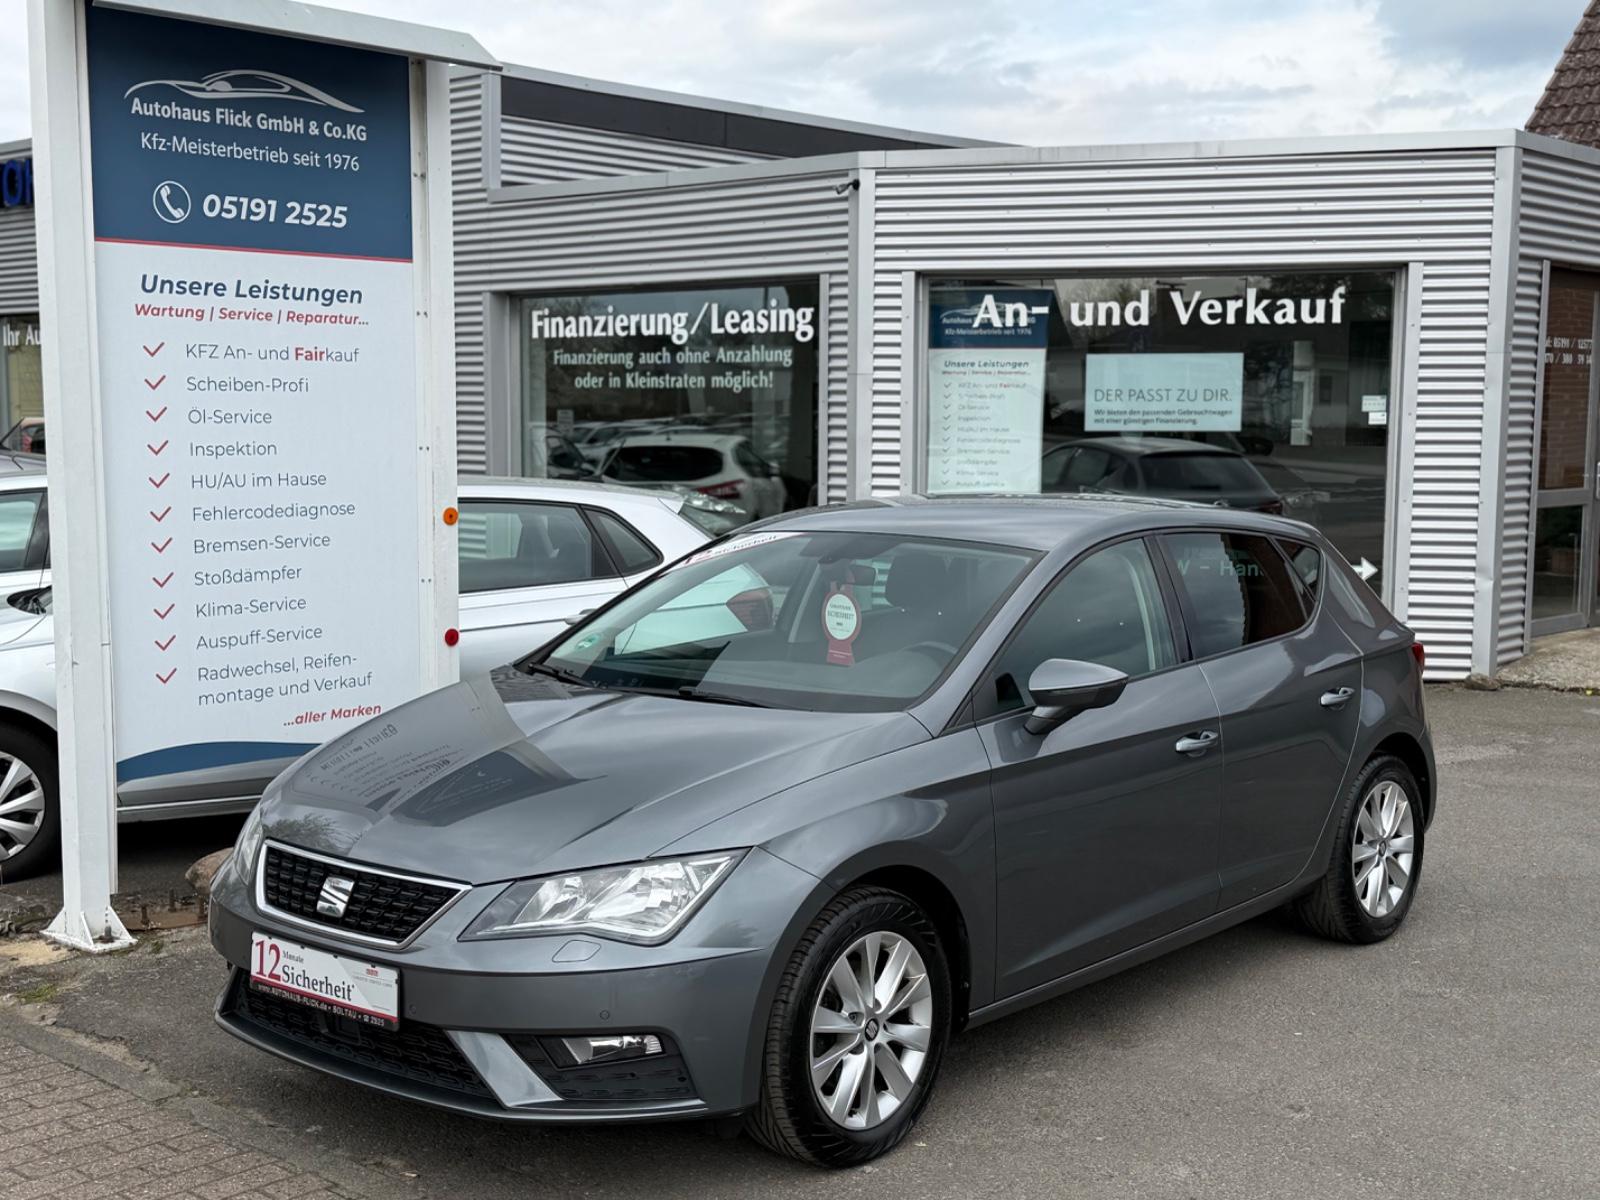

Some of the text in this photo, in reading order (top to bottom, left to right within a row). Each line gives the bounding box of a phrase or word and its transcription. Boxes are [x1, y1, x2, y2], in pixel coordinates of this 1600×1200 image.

[131, 97, 367, 142] Autohaus Flick GmbH & Co.KG
[141, 132, 360, 171] Kfz-Meisterbetrieb seit 1976
[203, 193, 348, 228] 05191 2525
[140, 273, 363, 307] Unsere Leistungen
[134, 303, 205, 322] Wartung
[218, 307, 273, 322] Service
[286, 310, 369, 327] Reparatur...
[972, 285, 1346, 328] An- und Verkauf
[531, 298, 815, 345] Finanzierung/Leasing
[2, 325, 20, 347] Ihr
[185, 343, 360, 362] KFZ An- und Fairkauf
[553, 344, 793, 368] Finanzierung auch ohne Anzahlung
[944, 360, 1030, 369] Unsere Leistungen
[186, 375, 310, 393] Scheiben-Profi
[574, 370, 774, 393] oder in Kleinstraten möglich!
[1094, 388, 1232, 402] DER PASST ZU DIR.
[188, 405, 272, 425] Öl-Service
[189, 441, 277, 460] Inspektion
[191, 471, 327, 490] HU/AU im Hause
[192, 502, 356, 522] Fehlercodediagnose
[193, 533, 331, 554] Bremsen-Service
[194, 565, 302, 586] Stoßdämpfer
[195, 596, 307, 618] Klima-Service
[196, 625, 323, 650] Auspuff-Service
[198, 652, 357, 682] Radwechsel, Reifen-
[198, 671, 373, 706] montage und Verkauf
[283, 703, 382, 727] ...aller Marken
[255, 939, 281, 982] 12
